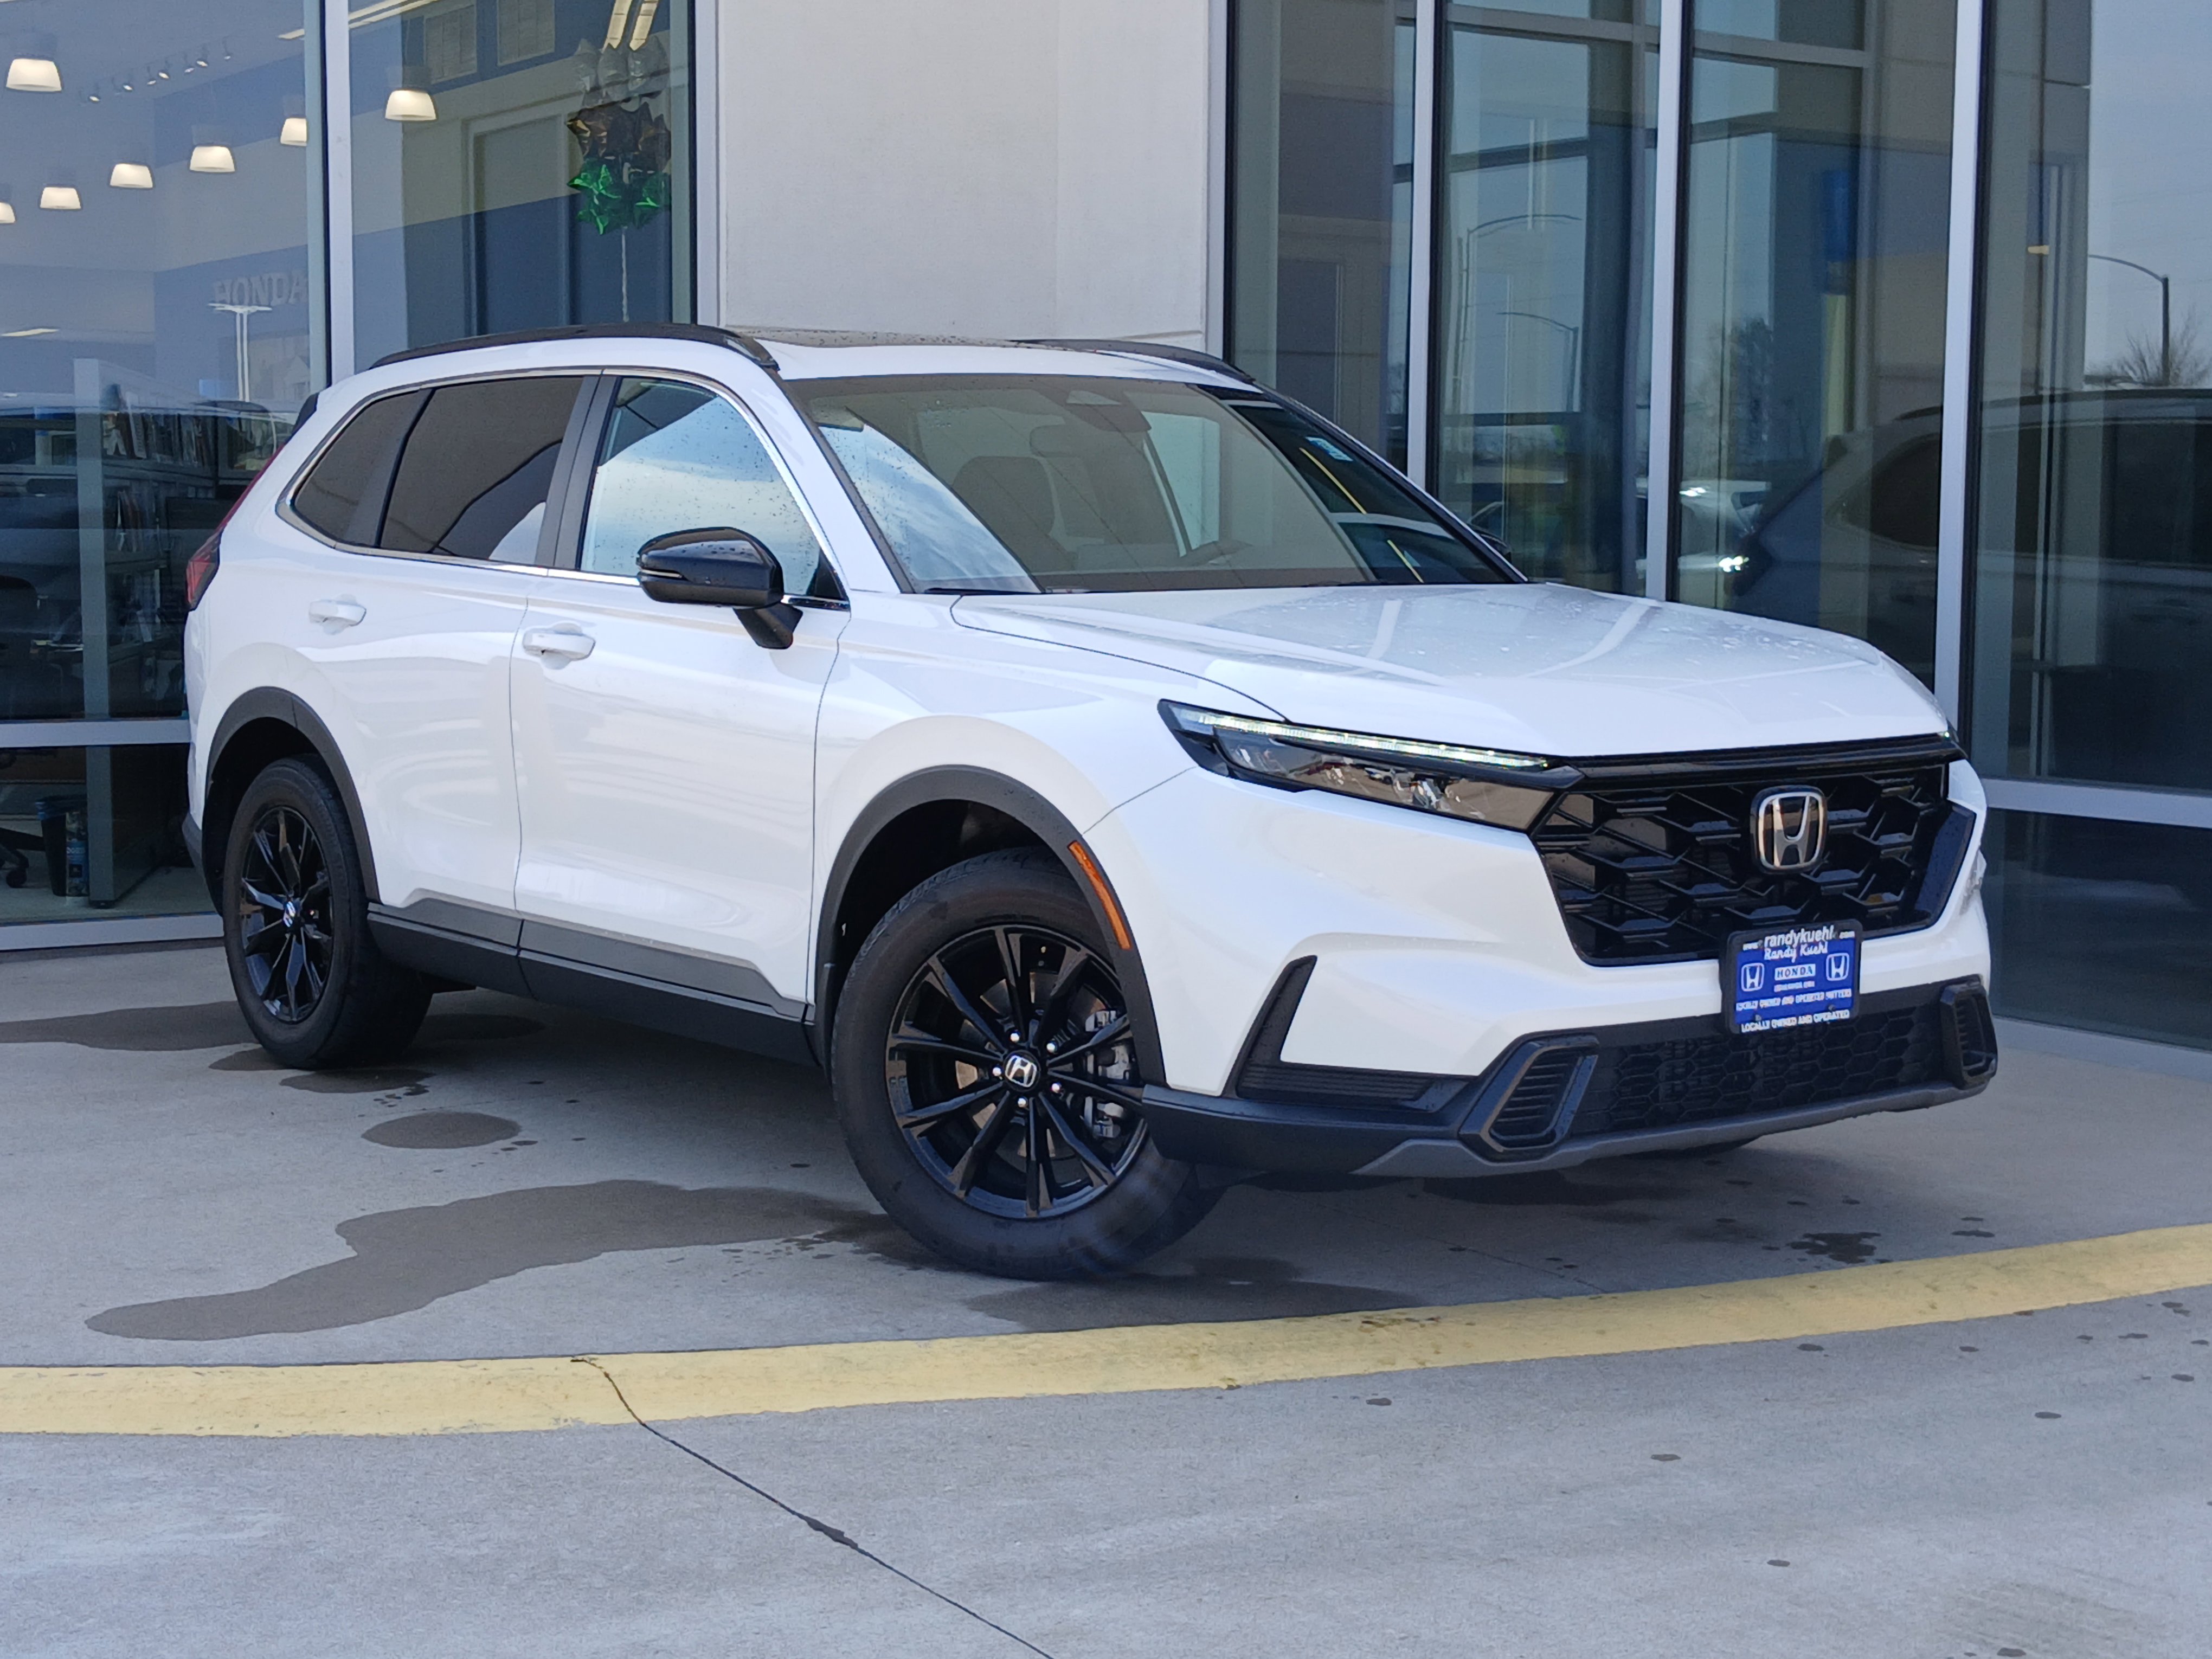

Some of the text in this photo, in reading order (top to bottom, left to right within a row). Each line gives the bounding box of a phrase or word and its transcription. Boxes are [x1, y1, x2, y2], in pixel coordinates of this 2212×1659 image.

[215, 272, 308, 306] HONDA
[1764, 924, 1834, 948] randykuehl
[1764, 941, 1828, 963] Randy Kuehl
[1777, 966, 1813, 978] HONDA
[1741, 1020, 1770, 1033] LOCALLY
